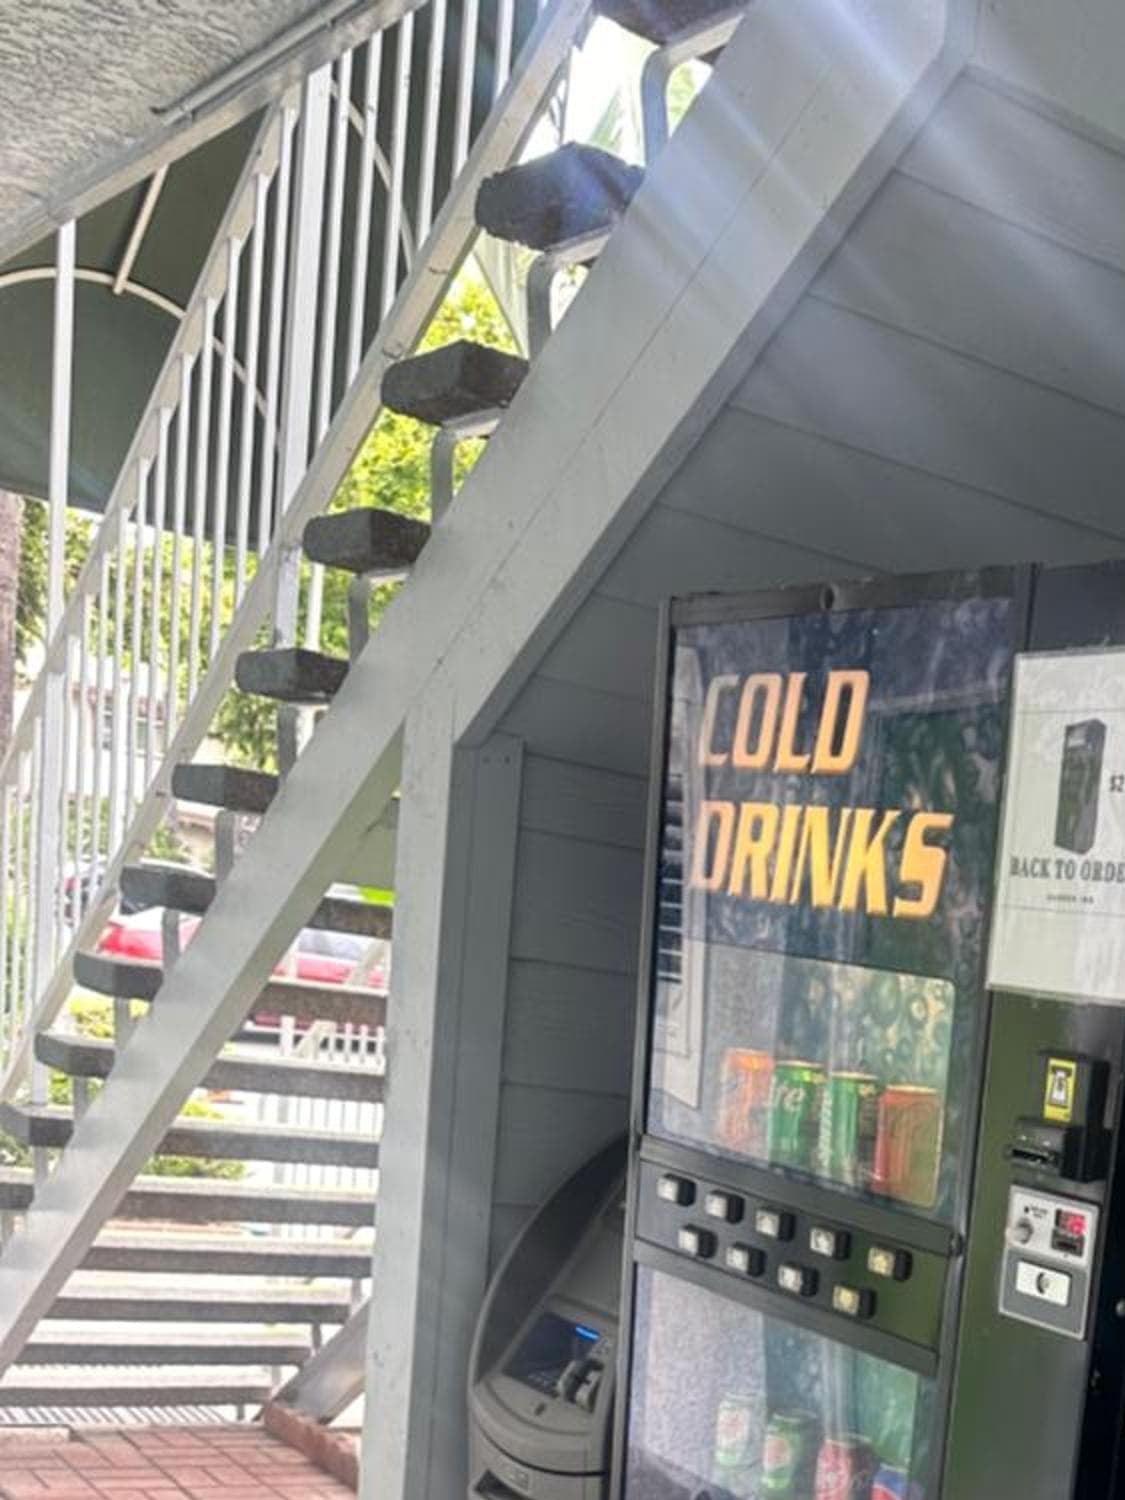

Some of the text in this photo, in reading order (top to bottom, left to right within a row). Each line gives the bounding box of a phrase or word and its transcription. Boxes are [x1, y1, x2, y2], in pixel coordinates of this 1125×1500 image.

[698, 669, 870, 775] COLD
[689, 800, 953, 918] DRINKS
[1055, 858, 1077, 880] TO
